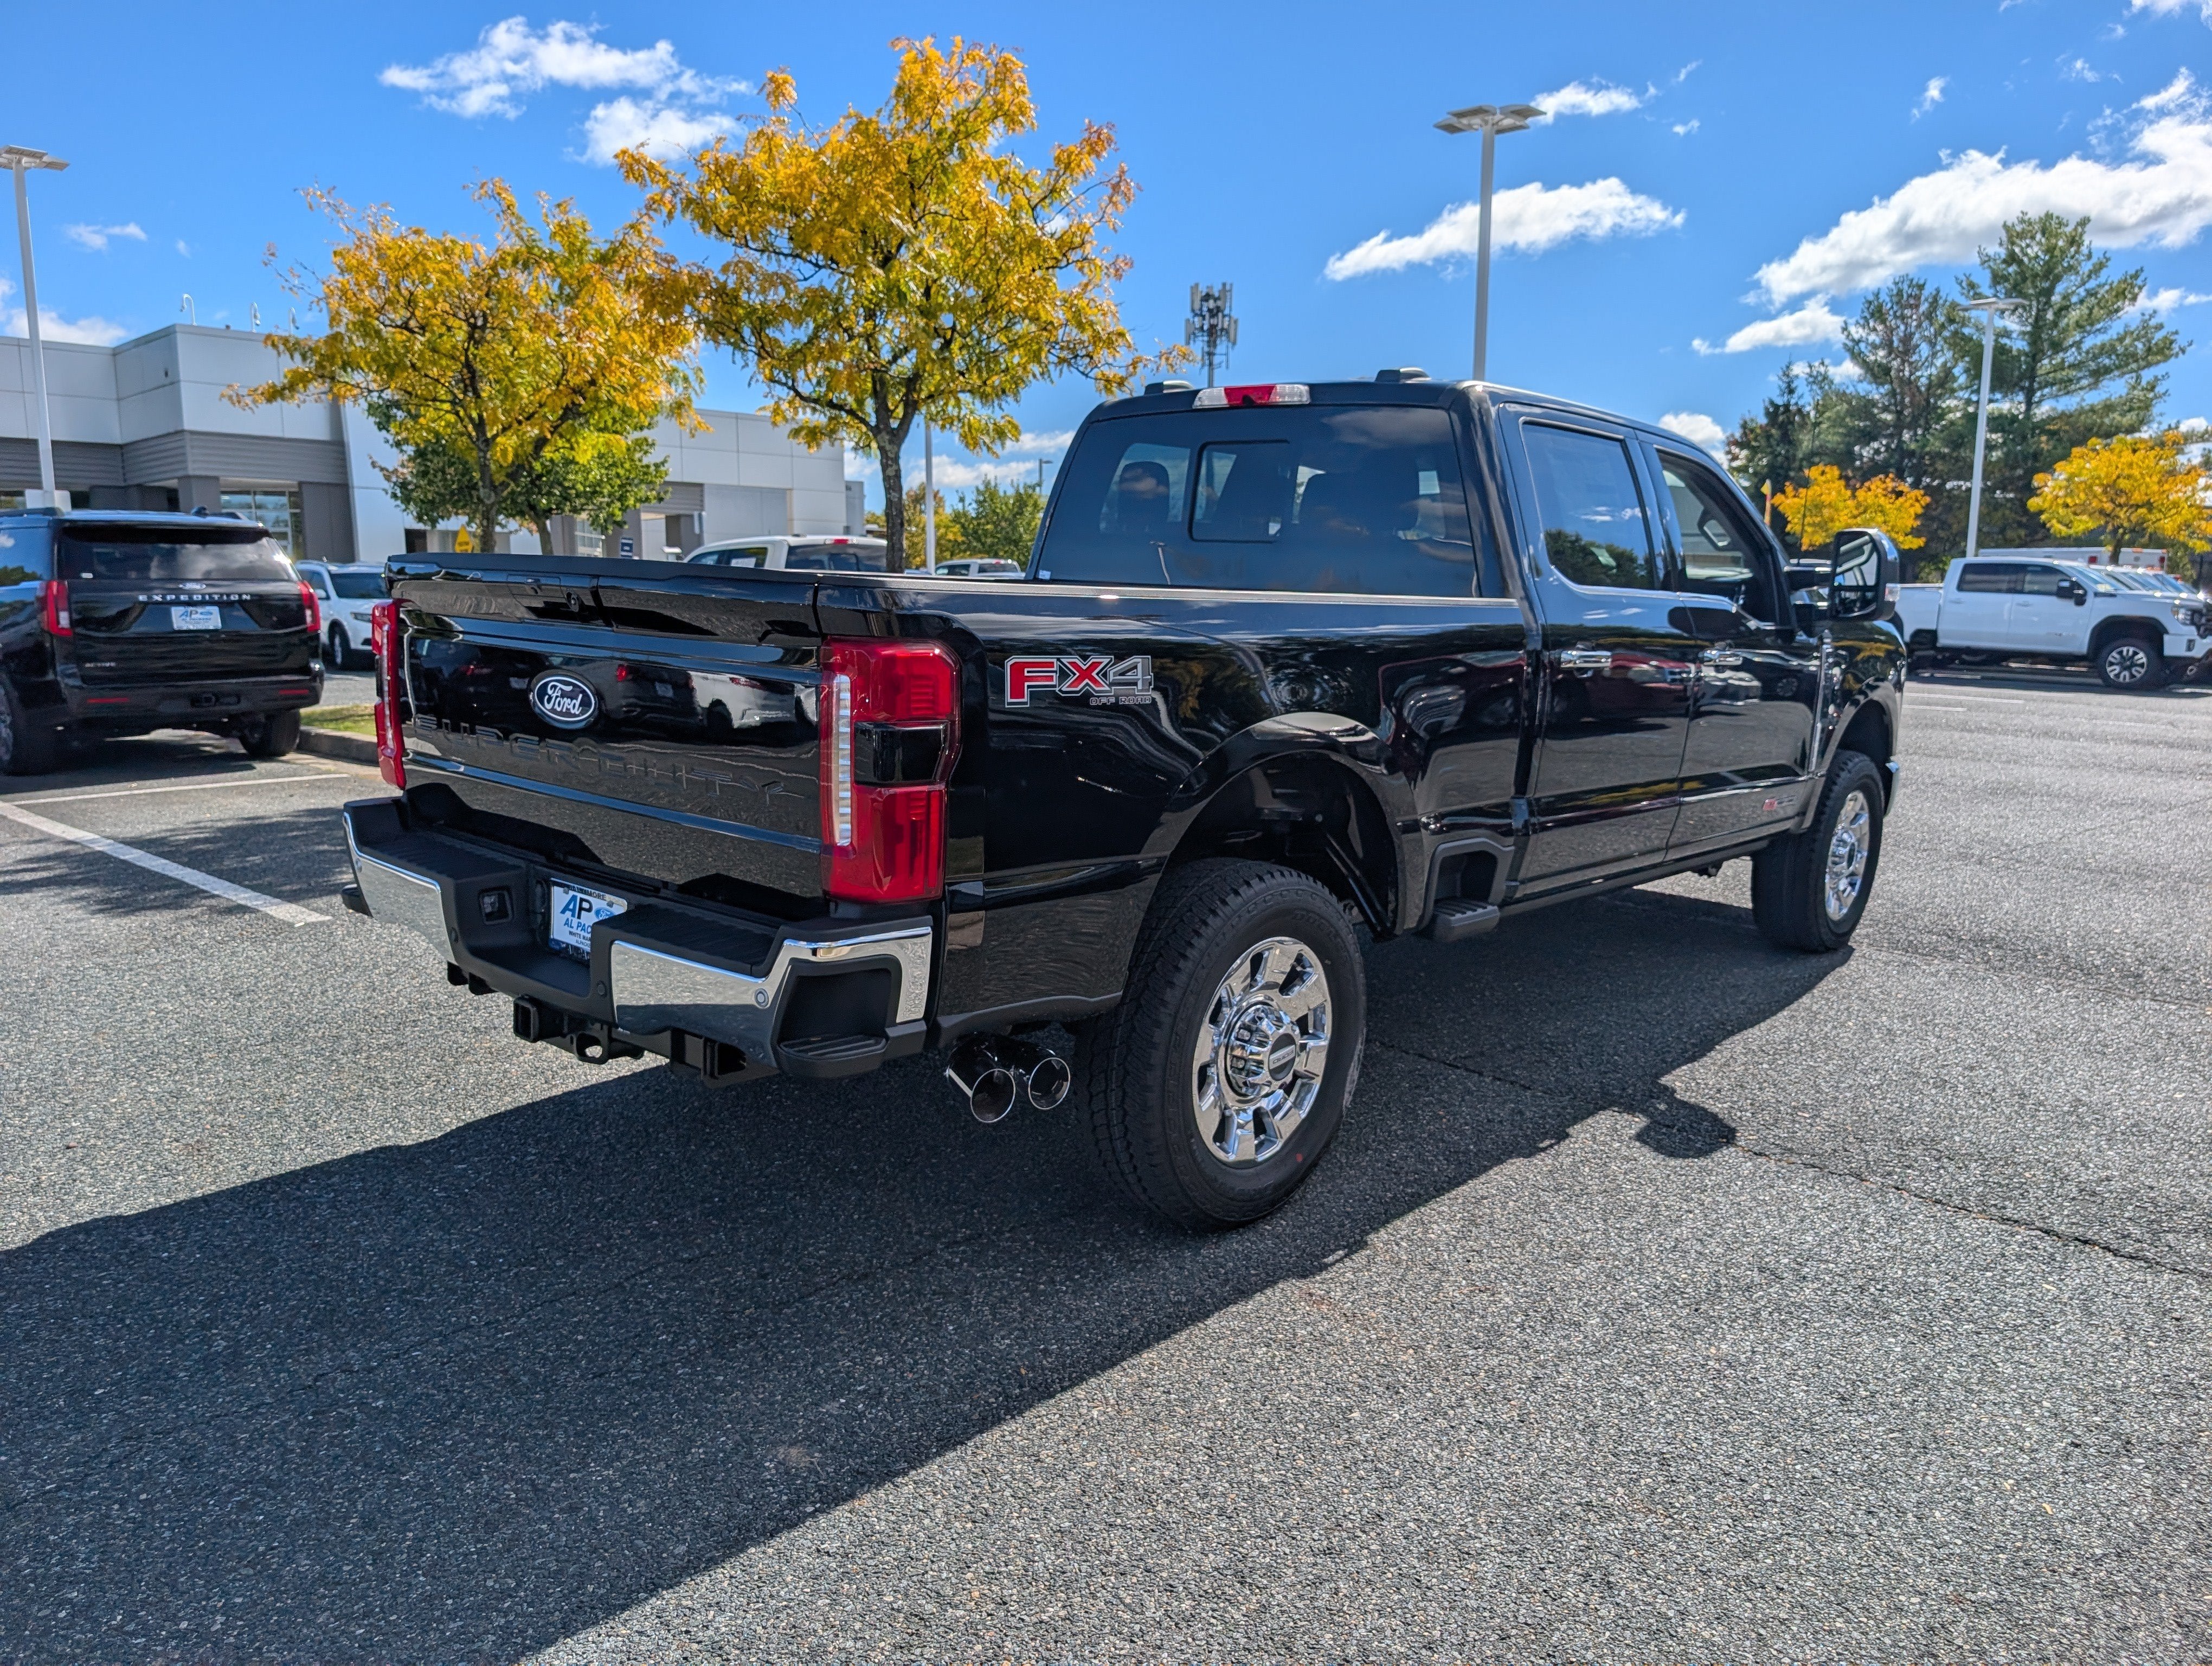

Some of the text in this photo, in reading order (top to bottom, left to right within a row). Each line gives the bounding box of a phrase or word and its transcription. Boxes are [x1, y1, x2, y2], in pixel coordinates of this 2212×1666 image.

[1005, 656, 1153, 708] FX4
[544, 682, 582, 714] Ford
[1090, 696, 1152, 705] OFF ROAD
[560, 894, 593, 920] AP
[564, 918, 574, 928] AL
[569, 930, 581, 939] WHITE
